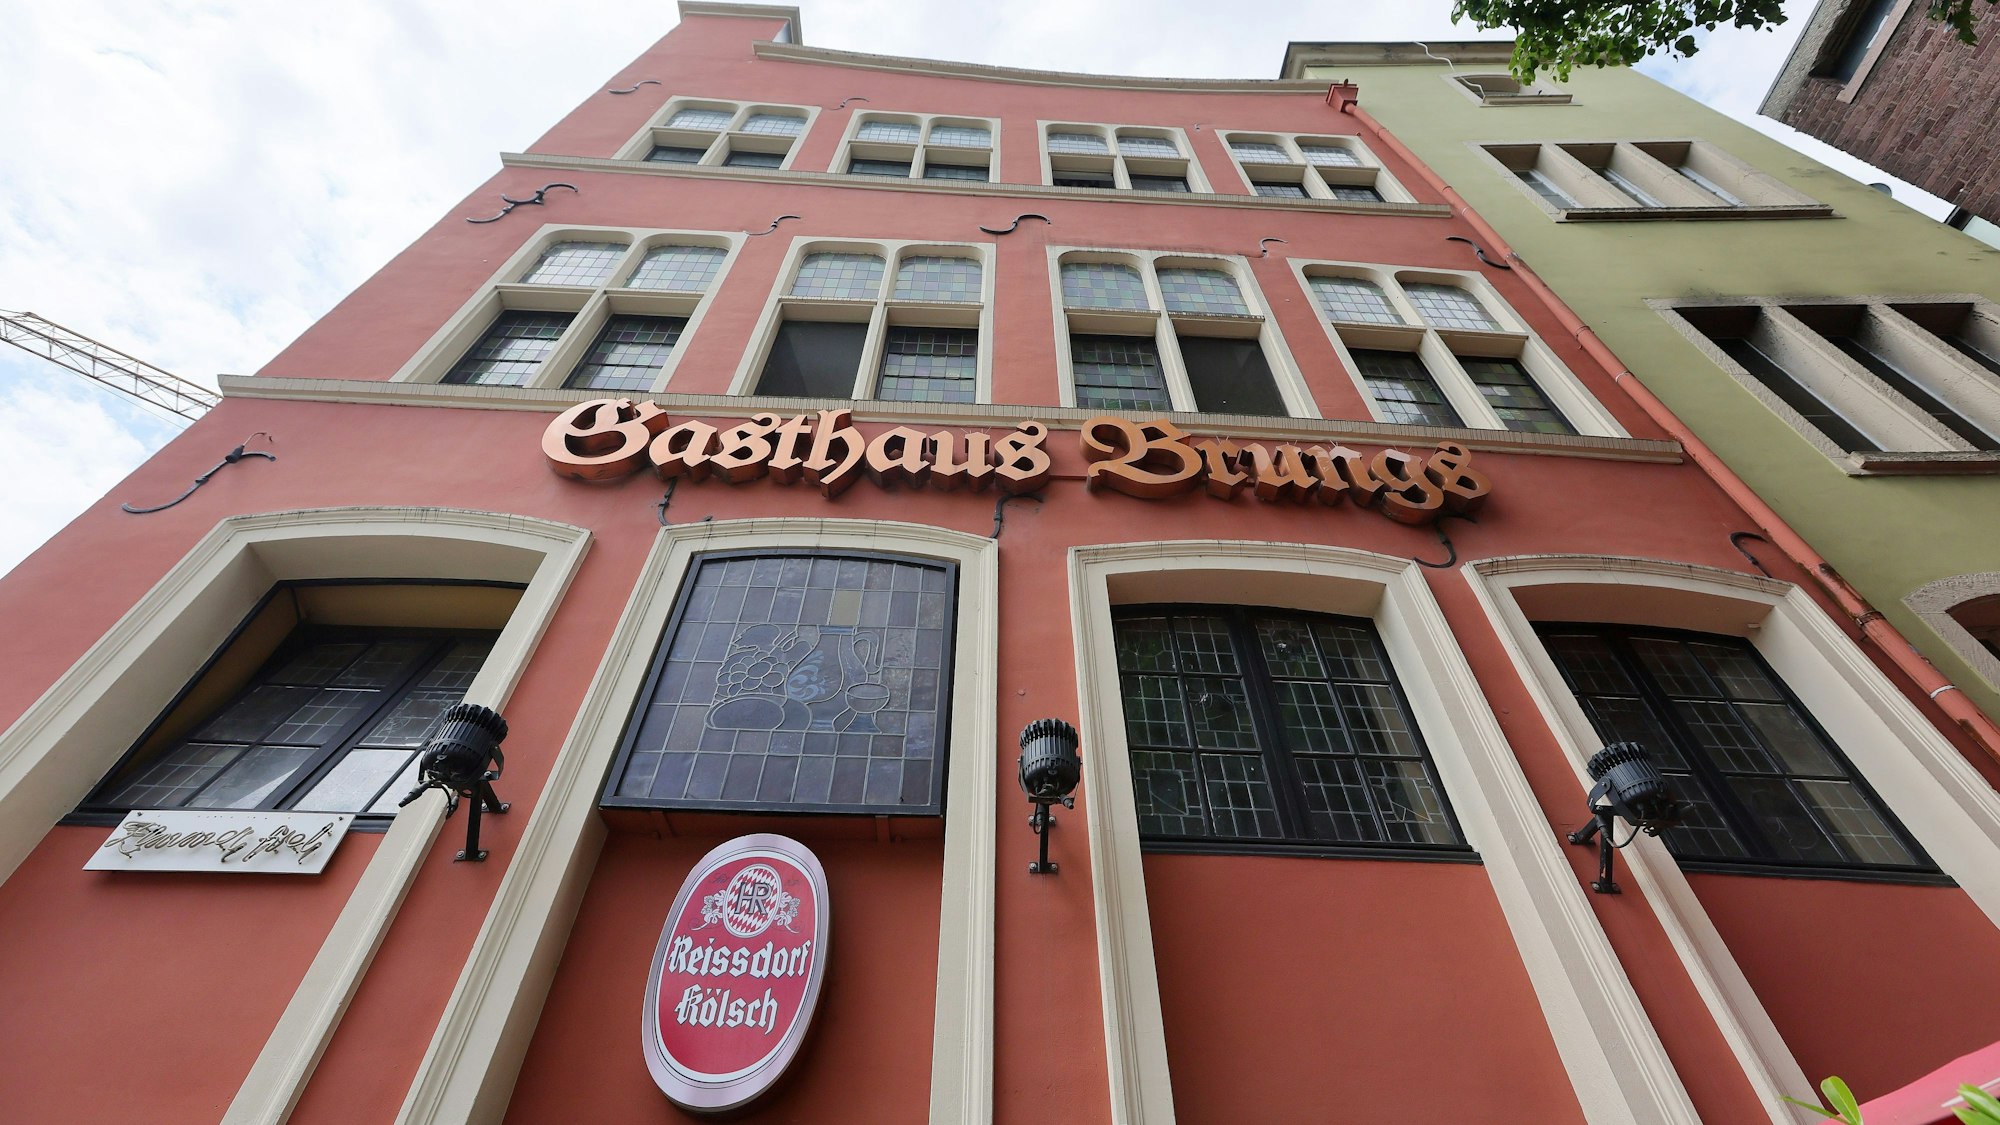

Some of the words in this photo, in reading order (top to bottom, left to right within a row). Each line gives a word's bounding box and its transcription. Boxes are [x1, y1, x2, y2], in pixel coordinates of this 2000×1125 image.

[541, 397, 1051, 497] Gasthaus
[1080, 416, 1491, 520] Brungs
[668, 934, 812, 977] Reissdorf
[674, 983, 778, 1035] Kölsch
